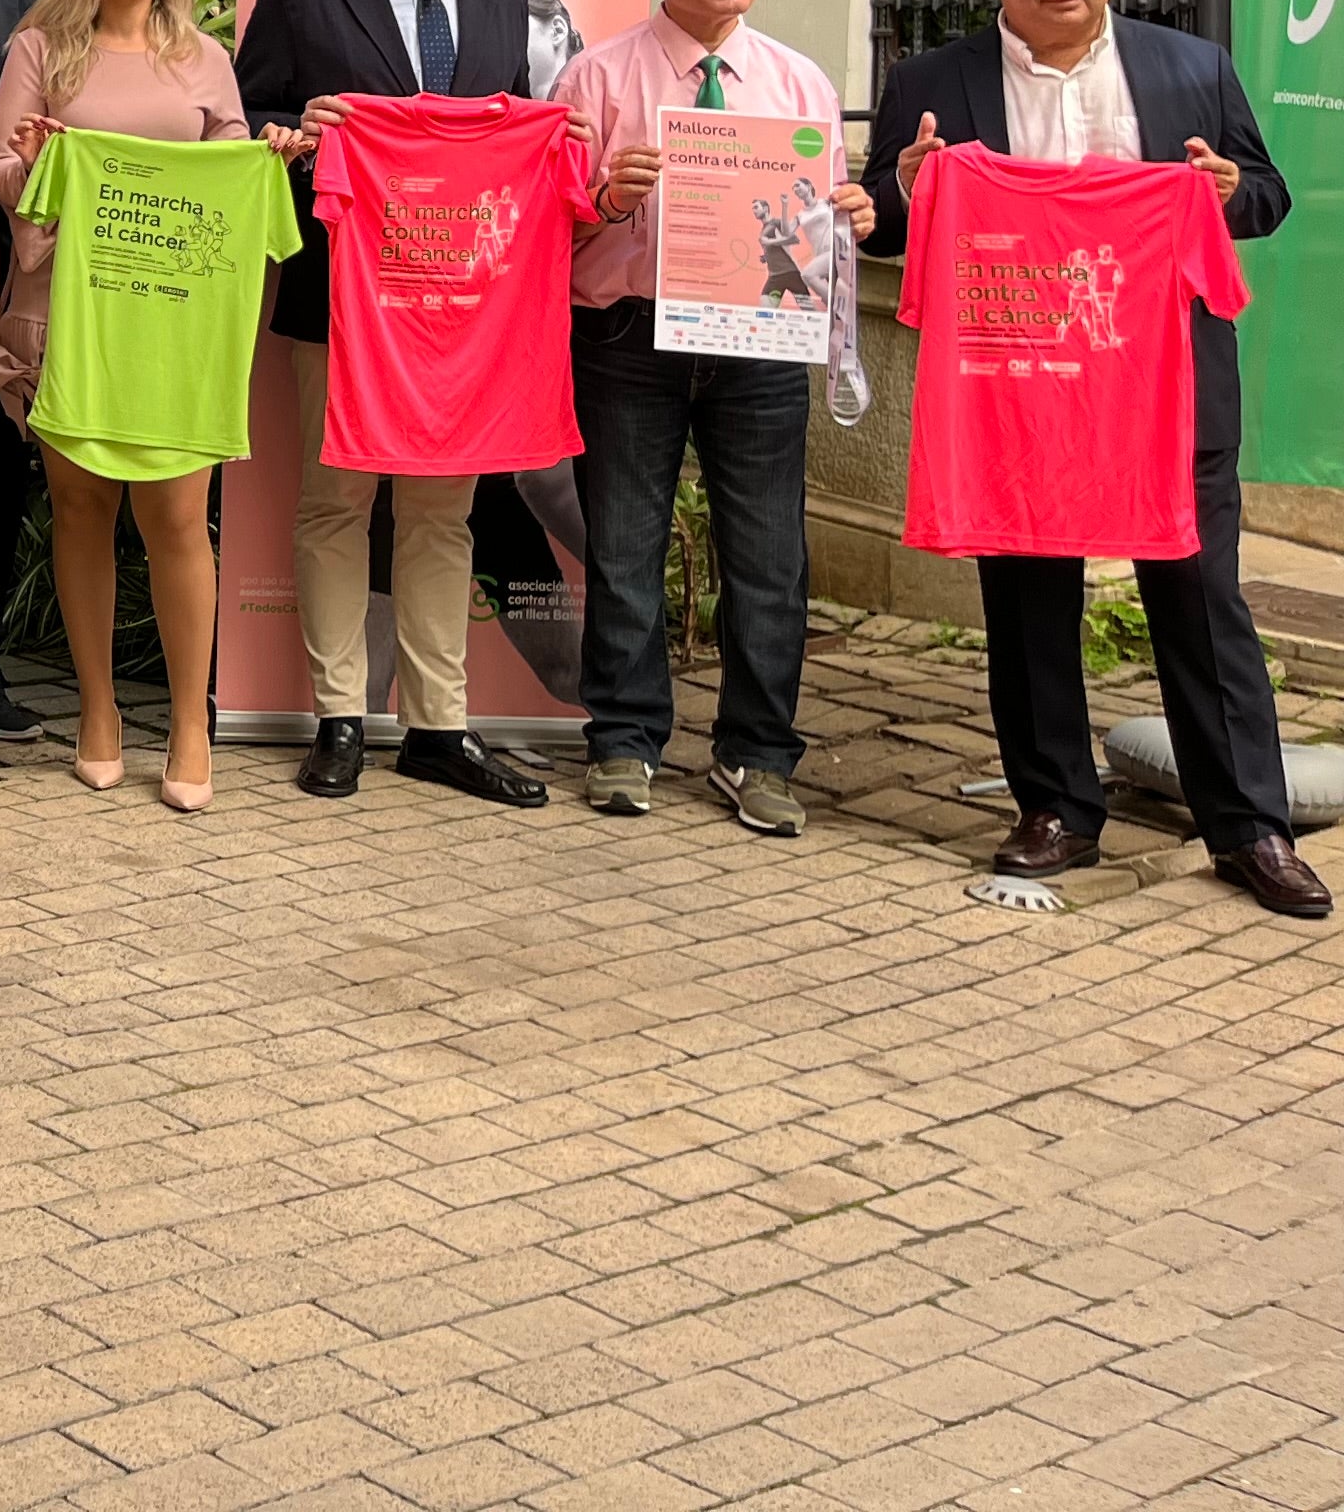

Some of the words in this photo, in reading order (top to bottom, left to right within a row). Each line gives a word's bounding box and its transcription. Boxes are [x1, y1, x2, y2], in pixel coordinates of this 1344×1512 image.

[668, 120, 737, 137] Mallorca
[668, 139, 688, 149] en
[692, 138, 752, 154] marcha
[668, 152, 720, 166] contra
[723, 154, 738, 168] el
[742, 156, 796, 172] cáncer
[99, 183, 123, 202] En
[129, 191, 204, 216] marcha
[670, 189, 683, 199] 27
[685, 189, 700, 200] de
[96, 206, 161, 227] contra
[384, 201, 408, 219] En
[415, 202, 492, 220] marcha
[94, 223, 113, 239] el
[118, 226, 187, 251] cáncer
[382, 224, 451, 242] contra
[381, 243, 402, 261] el
[407, 245, 478, 263] cáncer
[955, 260, 983, 278] En
[991, 261, 1088, 282] marcha
[131, 280, 150, 292] OK
[956, 284, 1037, 302] contra
[423, 295, 443, 305] OK
[957, 304, 977, 324] el
[984, 305, 1074, 325] cáncer
[1008, 359, 1032, 372] OK
[508, 579, 570, 593] asociación
[240, 602, 298, 614] #TodosCo
[508, 594, 546, 606] contra
[548, 594, 559, 607] el
[507, 610, 523, 621] en
[525, 609, 550, 622] Illes
